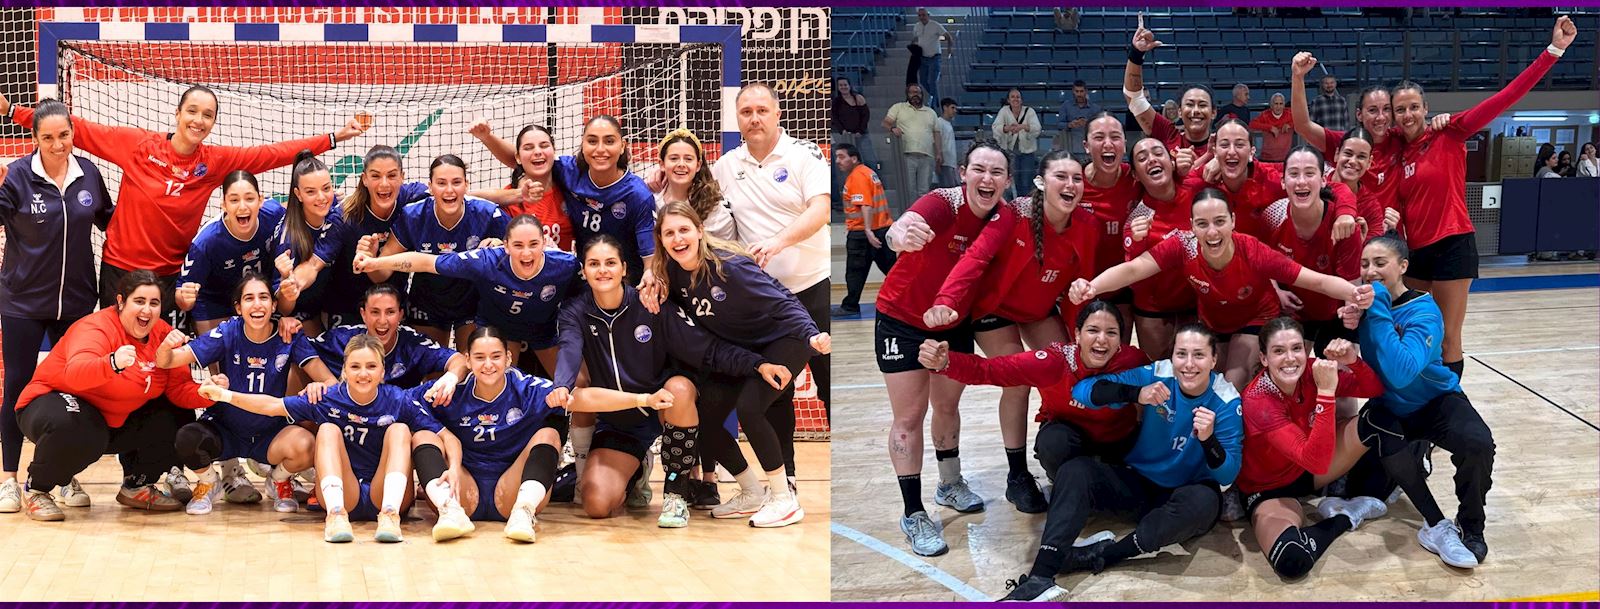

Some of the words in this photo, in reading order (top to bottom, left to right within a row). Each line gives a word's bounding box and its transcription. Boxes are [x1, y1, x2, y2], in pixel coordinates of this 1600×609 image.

[165, 180, 185, 197] 12
[31, 203, 47, 214] N.C
[582, 210, 602, 233] 18
[1041, 270, 1060, 283] 35
[509, 300, 524, 315] 5
[691, 296, 715, 317] 22
[168, 309, 186, 329] 12
[884, 338, 899, 354] 14
[882, 353, 904, 361] Kempa
[144, 375, 152, 394] 1
[246, 371, 265, 393] 11
[343, 424, 369, 446] 87
[473, 424, 496, 442] 21
[1172, 436, 1188, 451] 12
